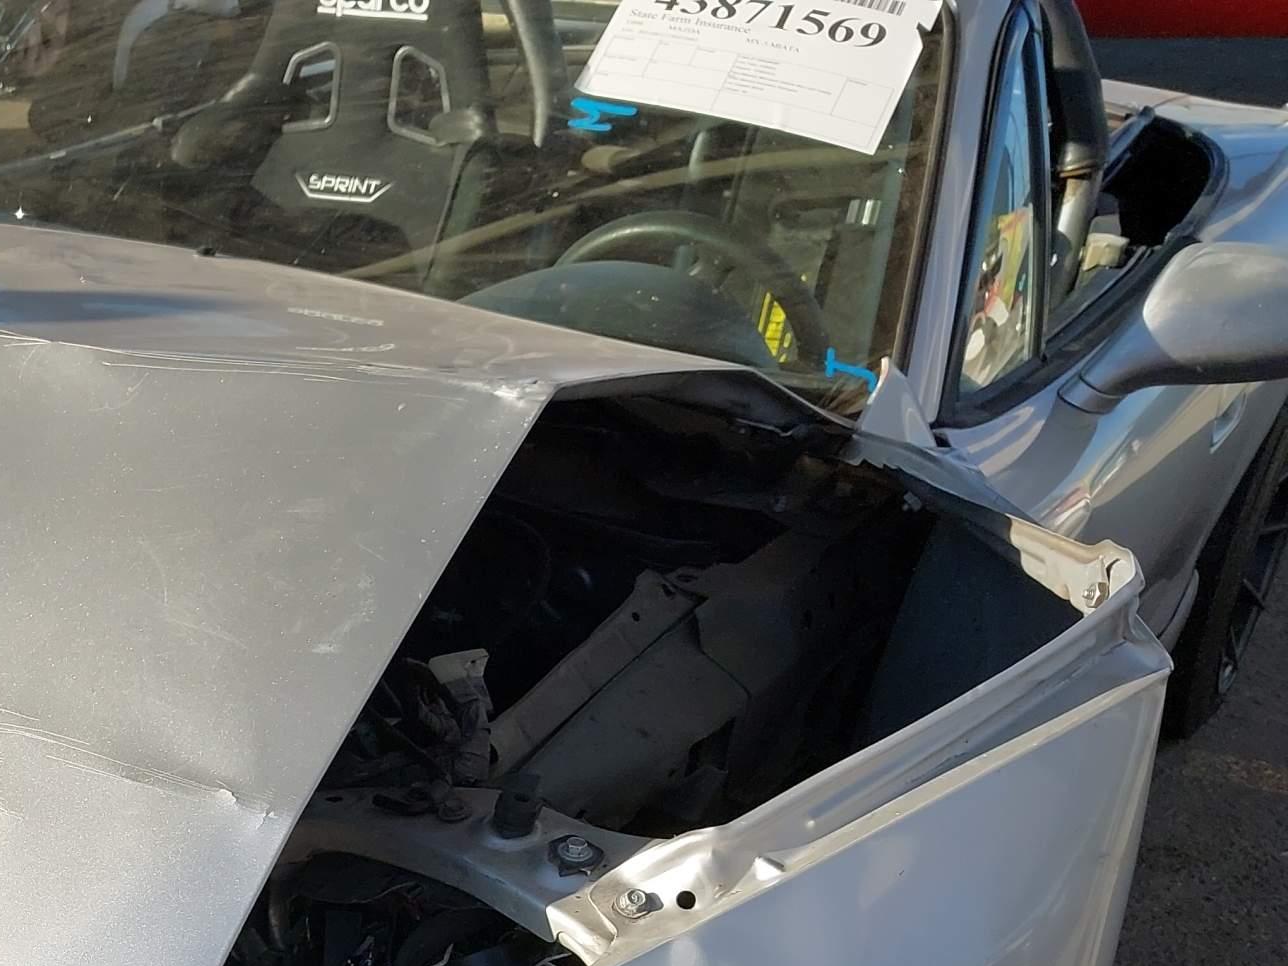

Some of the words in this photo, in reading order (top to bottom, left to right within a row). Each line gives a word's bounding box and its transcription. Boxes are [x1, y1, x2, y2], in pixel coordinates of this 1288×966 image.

[630, 9, 658, 20] State
[661, 13, 692, 25] Farm
[695, 17, 752, 34] Insurance
[308, 174, 381, 195] SPRINT
